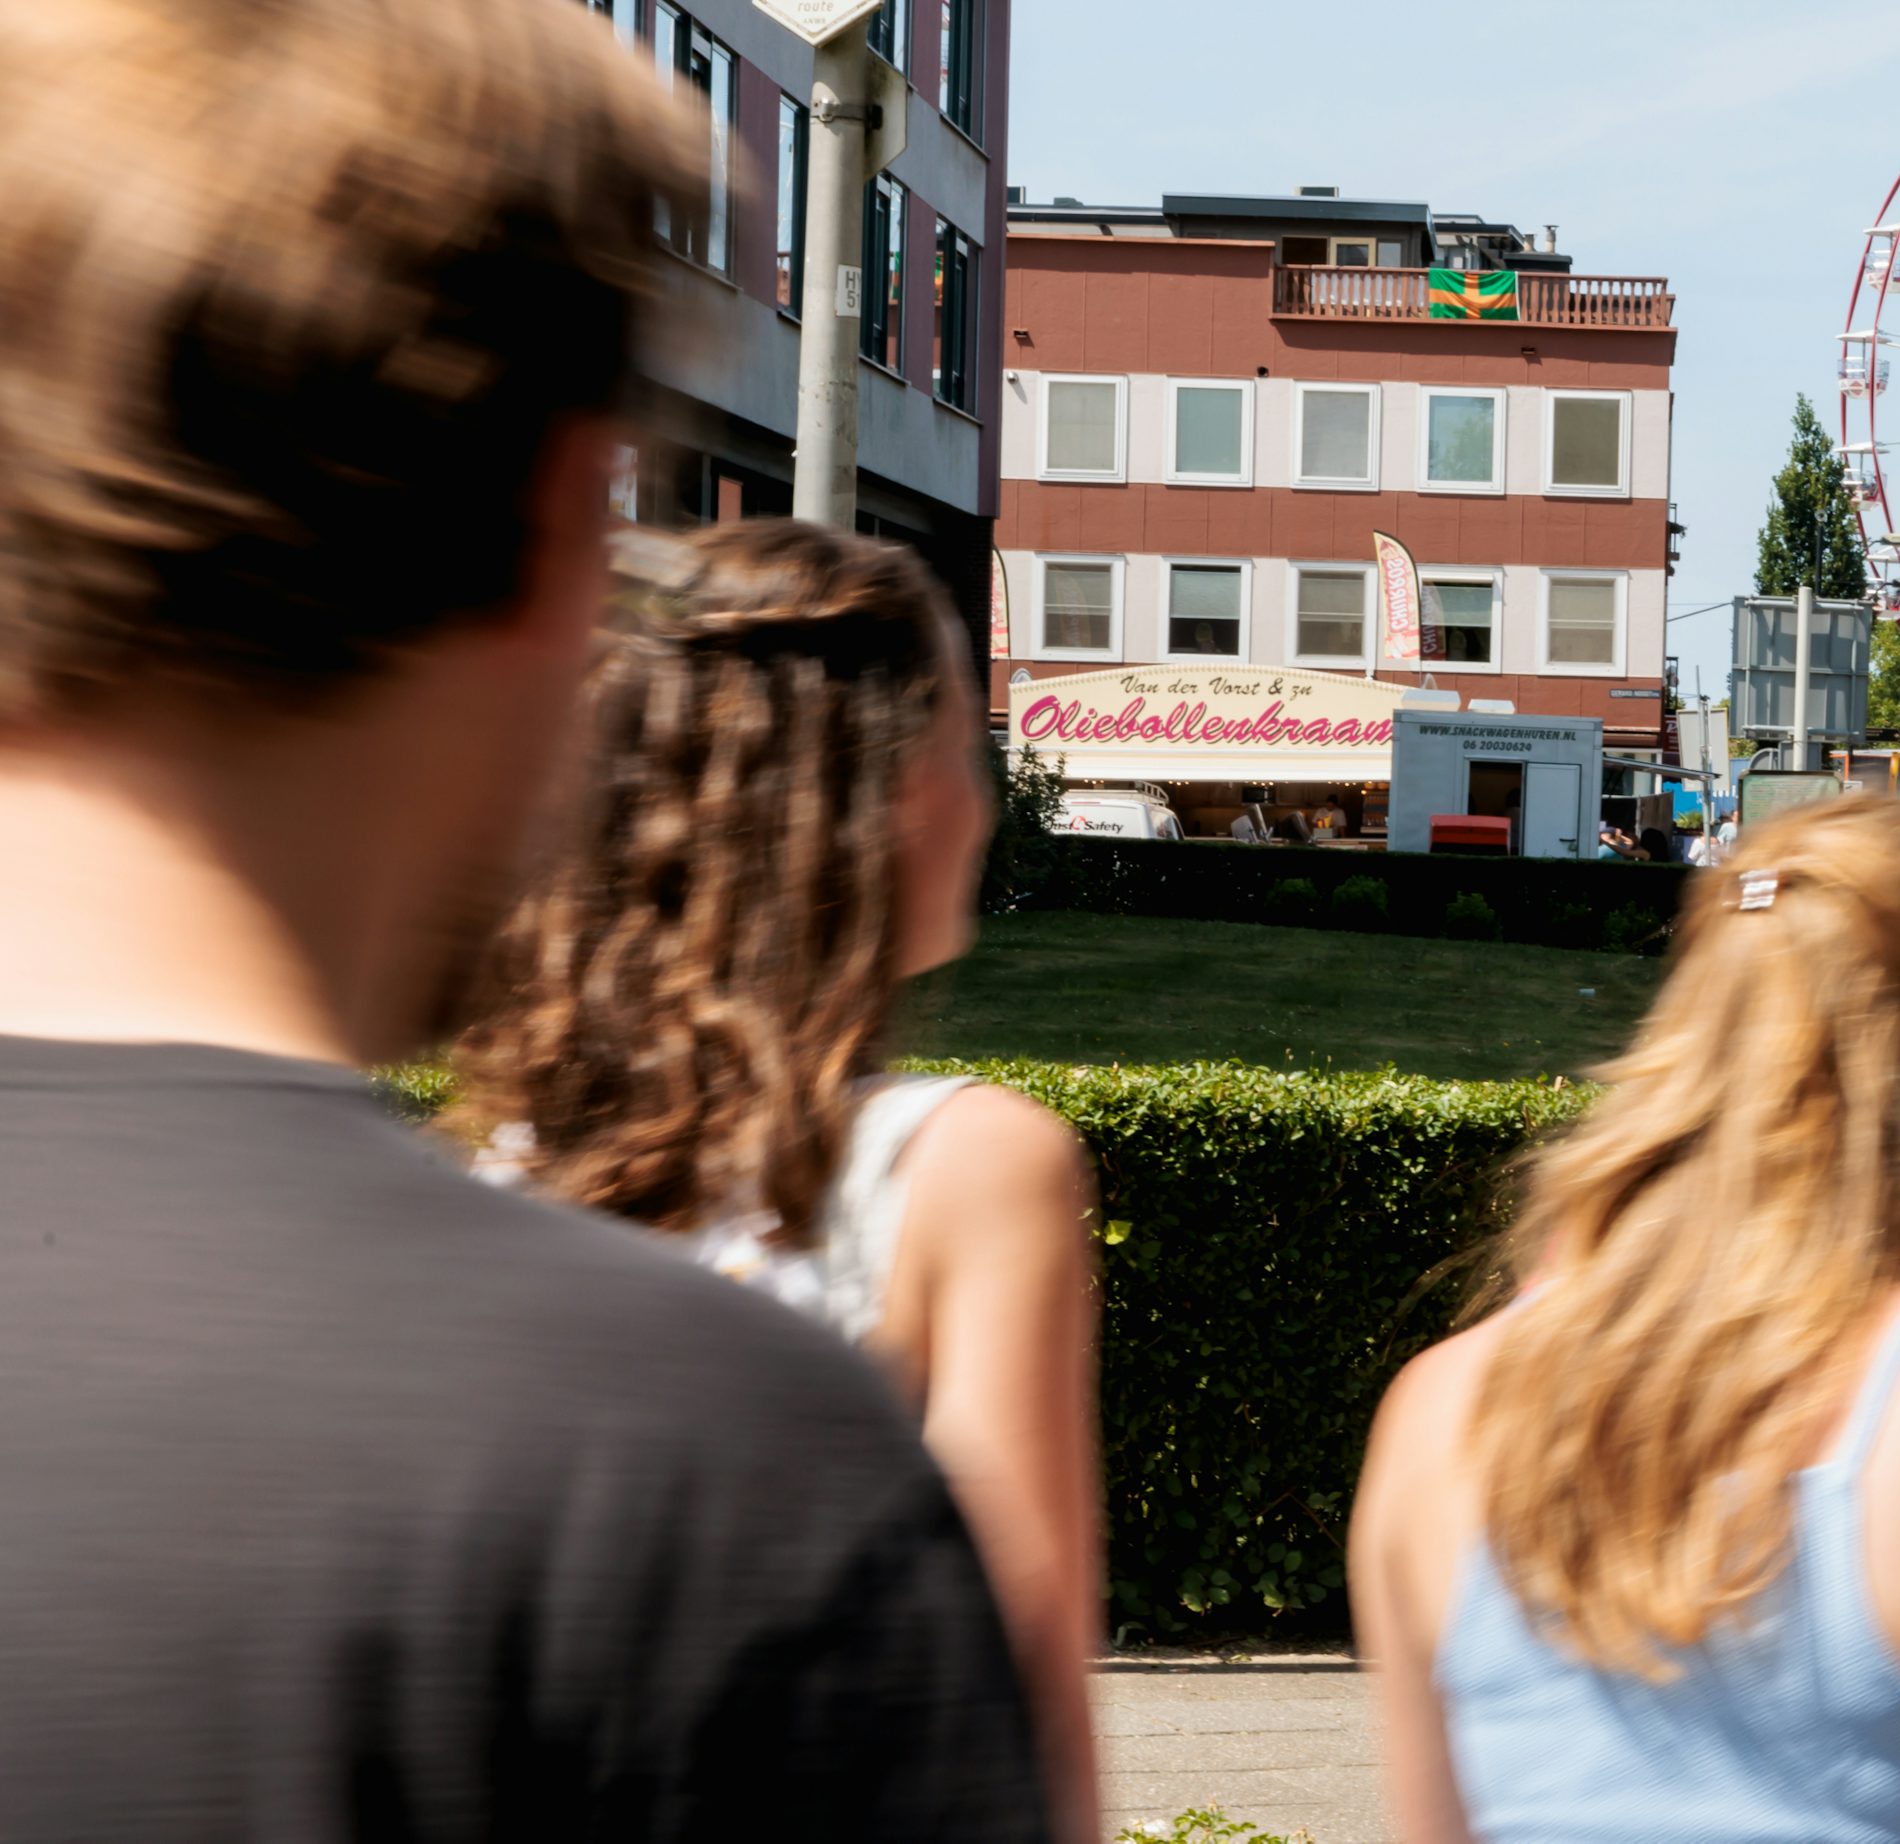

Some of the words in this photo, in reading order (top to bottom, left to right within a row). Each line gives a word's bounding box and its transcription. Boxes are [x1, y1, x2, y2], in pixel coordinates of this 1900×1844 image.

[798, 1, 834, 13] route
[1120, 675, 1159, 695] Van
[1168, 677, 1200, 695] der
[1208, 675, 1261, 697] Vorst
[1267, 676, 1284, 696] &
[1020, 694, 1393, 747] Oliebollenkraam
[1419, 725, 1577, 741] WWW.SNACKWAGENHUREN.NL
[1463, 740, 1477, 750] 06
[1084, 820, 1124, 834] Safety
